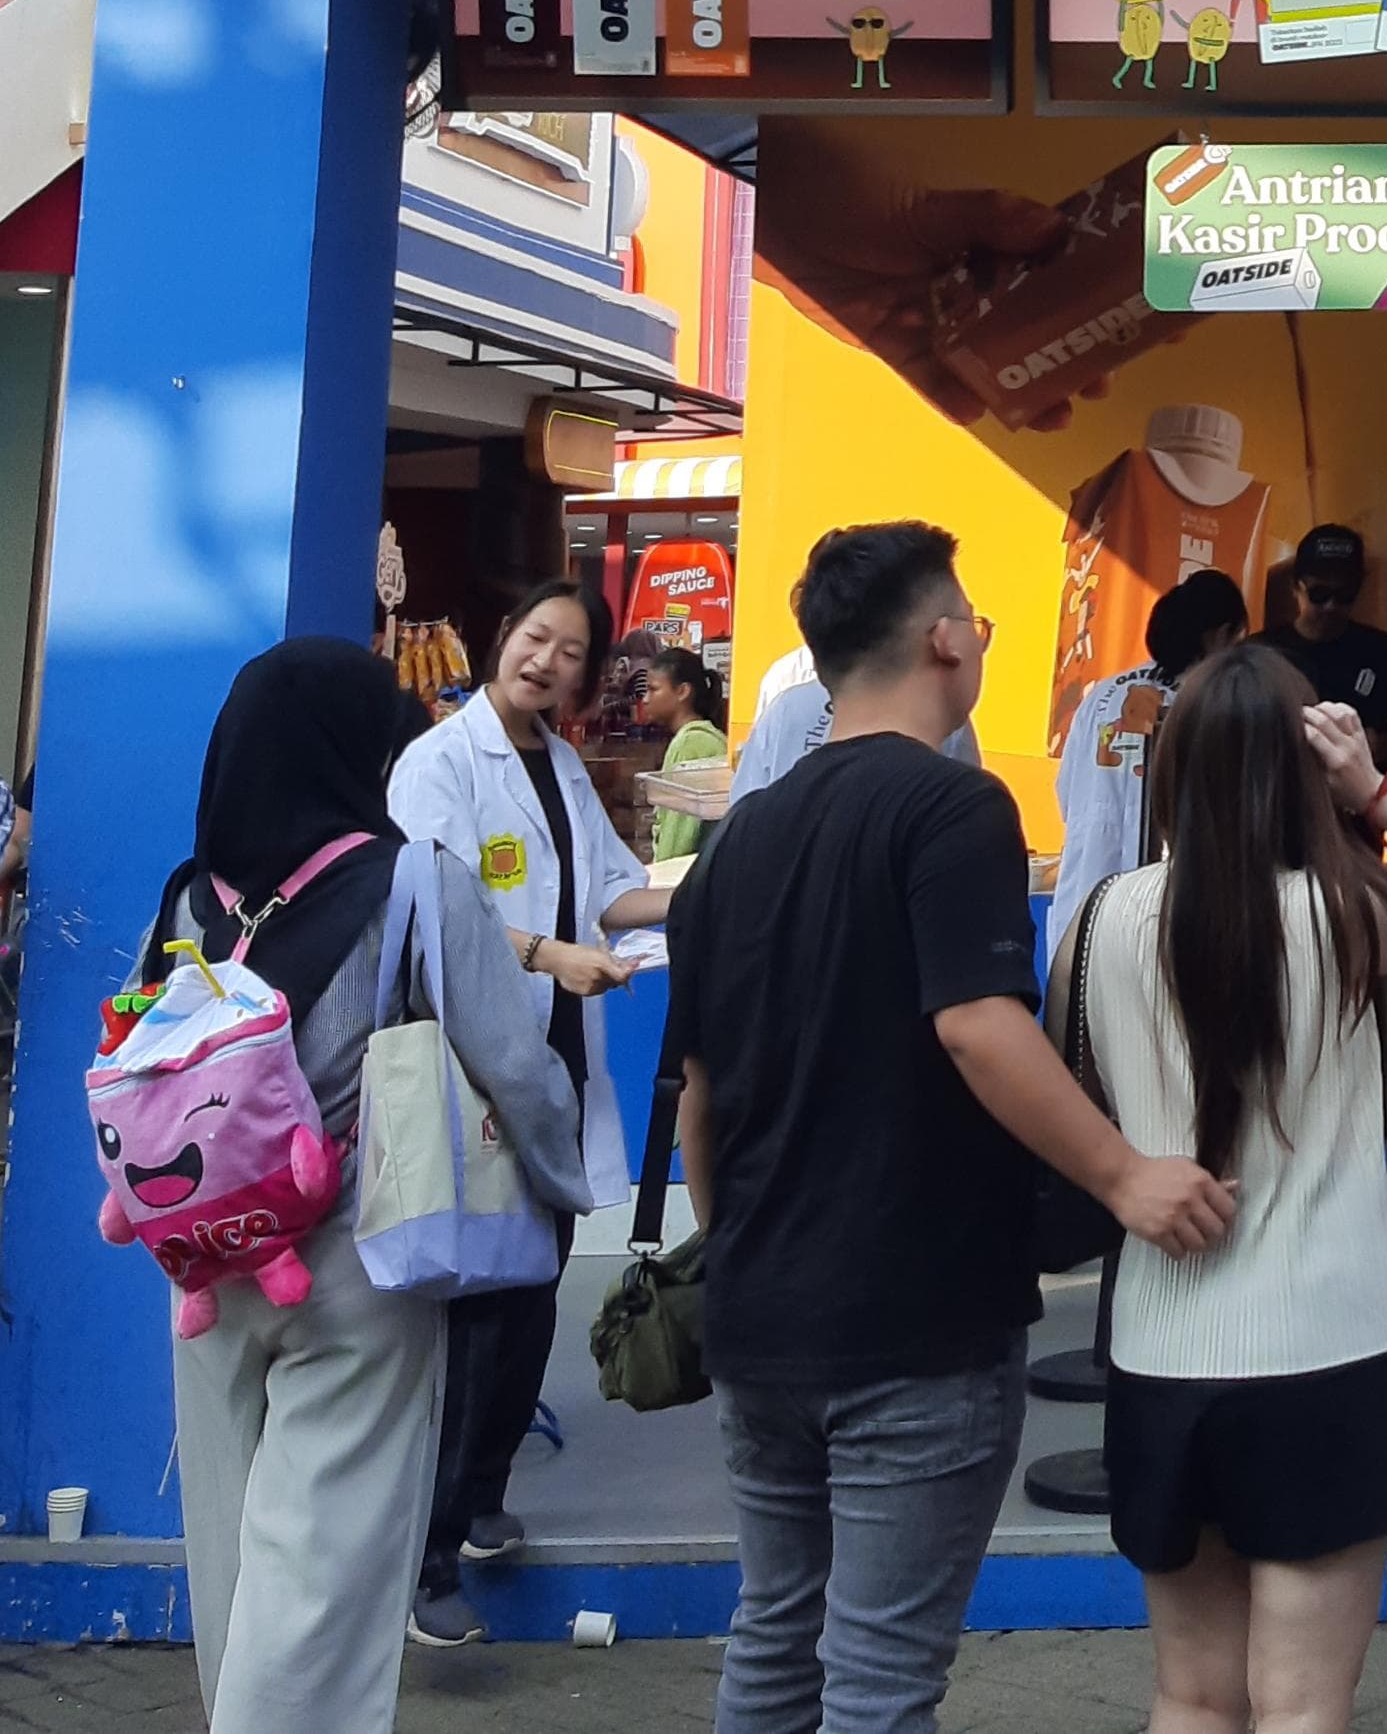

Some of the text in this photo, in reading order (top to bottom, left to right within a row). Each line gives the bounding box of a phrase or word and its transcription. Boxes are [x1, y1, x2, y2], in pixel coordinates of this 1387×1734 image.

[1158, 213, 1286, 255] Kasir
[1201, 258, 1293, 289] OATSIDE
[997, 291, 1155, 390] OATSIDE
[650, 566, 707, 588] DIPPING
[668, 577, 715, 596] SAUCE
[804, 716, 830, 751] The
